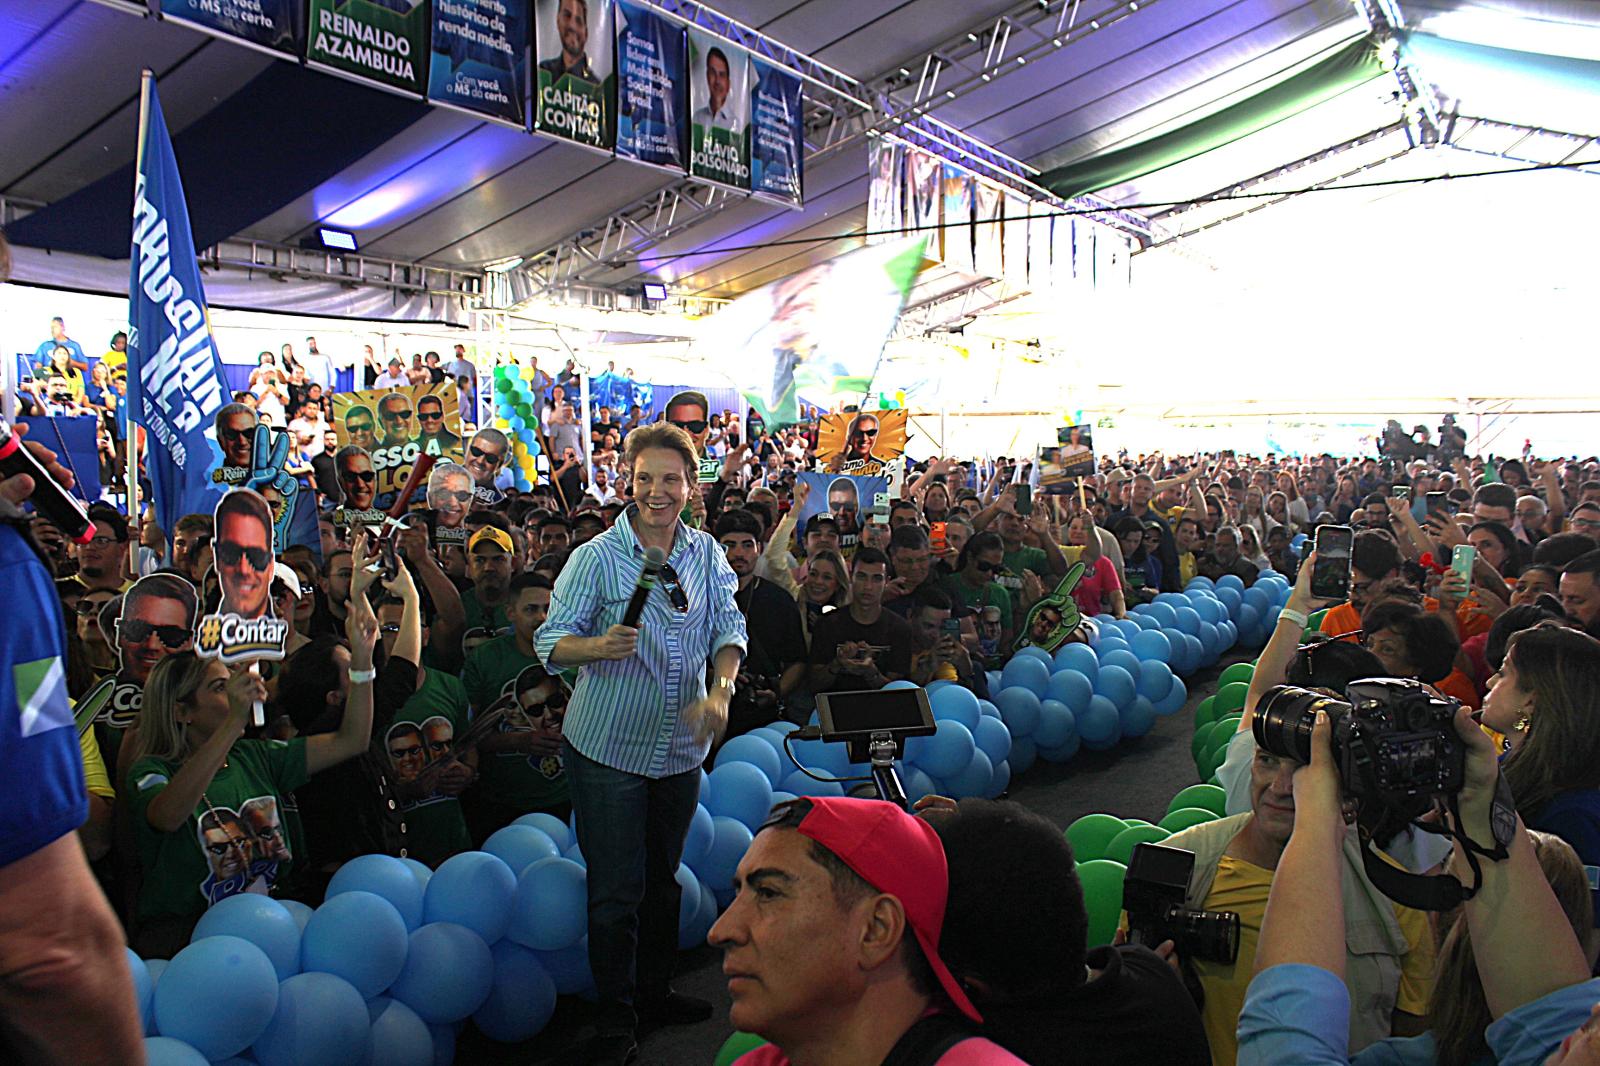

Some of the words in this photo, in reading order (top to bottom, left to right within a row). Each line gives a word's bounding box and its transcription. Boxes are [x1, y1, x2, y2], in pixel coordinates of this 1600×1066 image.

[320, 9, 411, 57] REINALDO
[439, 1, 489, 27] histórico
[490, 15, 506, 34] da
[439, 19, 476, 41] renda
[477, 33, 514, 56] média.
[314, 31, 416, 82] AZAMBUJA
[454, 82, 470, 97] MS
[543, 85, 600, 119] CAPITÃO
[692, 150, 749, 178] BOLSONARO
[703, 136, 739, 163] FLÁVIO
[369, 442, 421, 471] SSO
[424, 438, 442, 456] A
[213, 467, 249, 482] #Rein
[201, 618, 286, 648] #Contar
